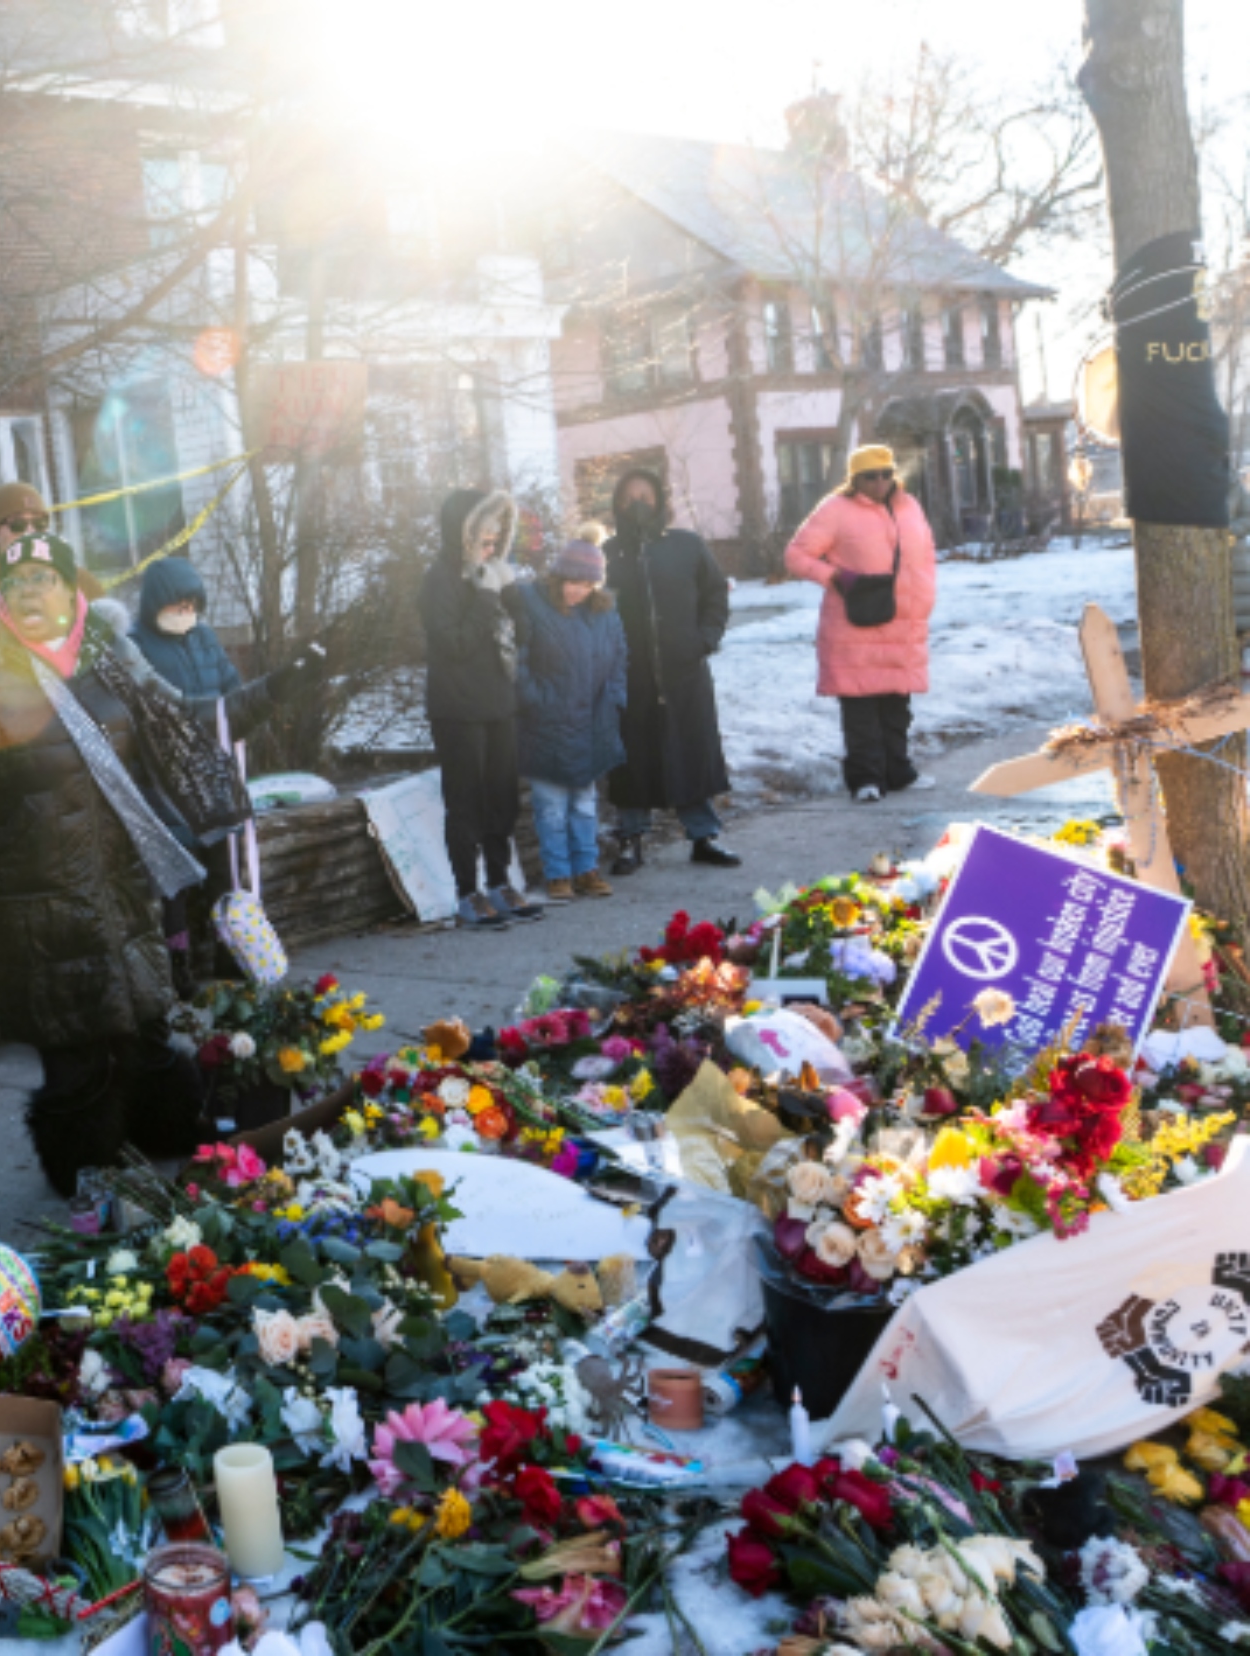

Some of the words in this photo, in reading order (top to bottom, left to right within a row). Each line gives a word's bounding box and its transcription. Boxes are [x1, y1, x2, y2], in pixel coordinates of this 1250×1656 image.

[1062, 868, 1107, 903] city
[1037, 900, 1088, 953] broken
[1083, 887, 1137, 955] injustice
[1037, 951, 1067, 982] our
[1068, 952, 1112, 992] from
[1126, 941, 1159, 979] ever
[1111, 973, 1147, 1010] and
